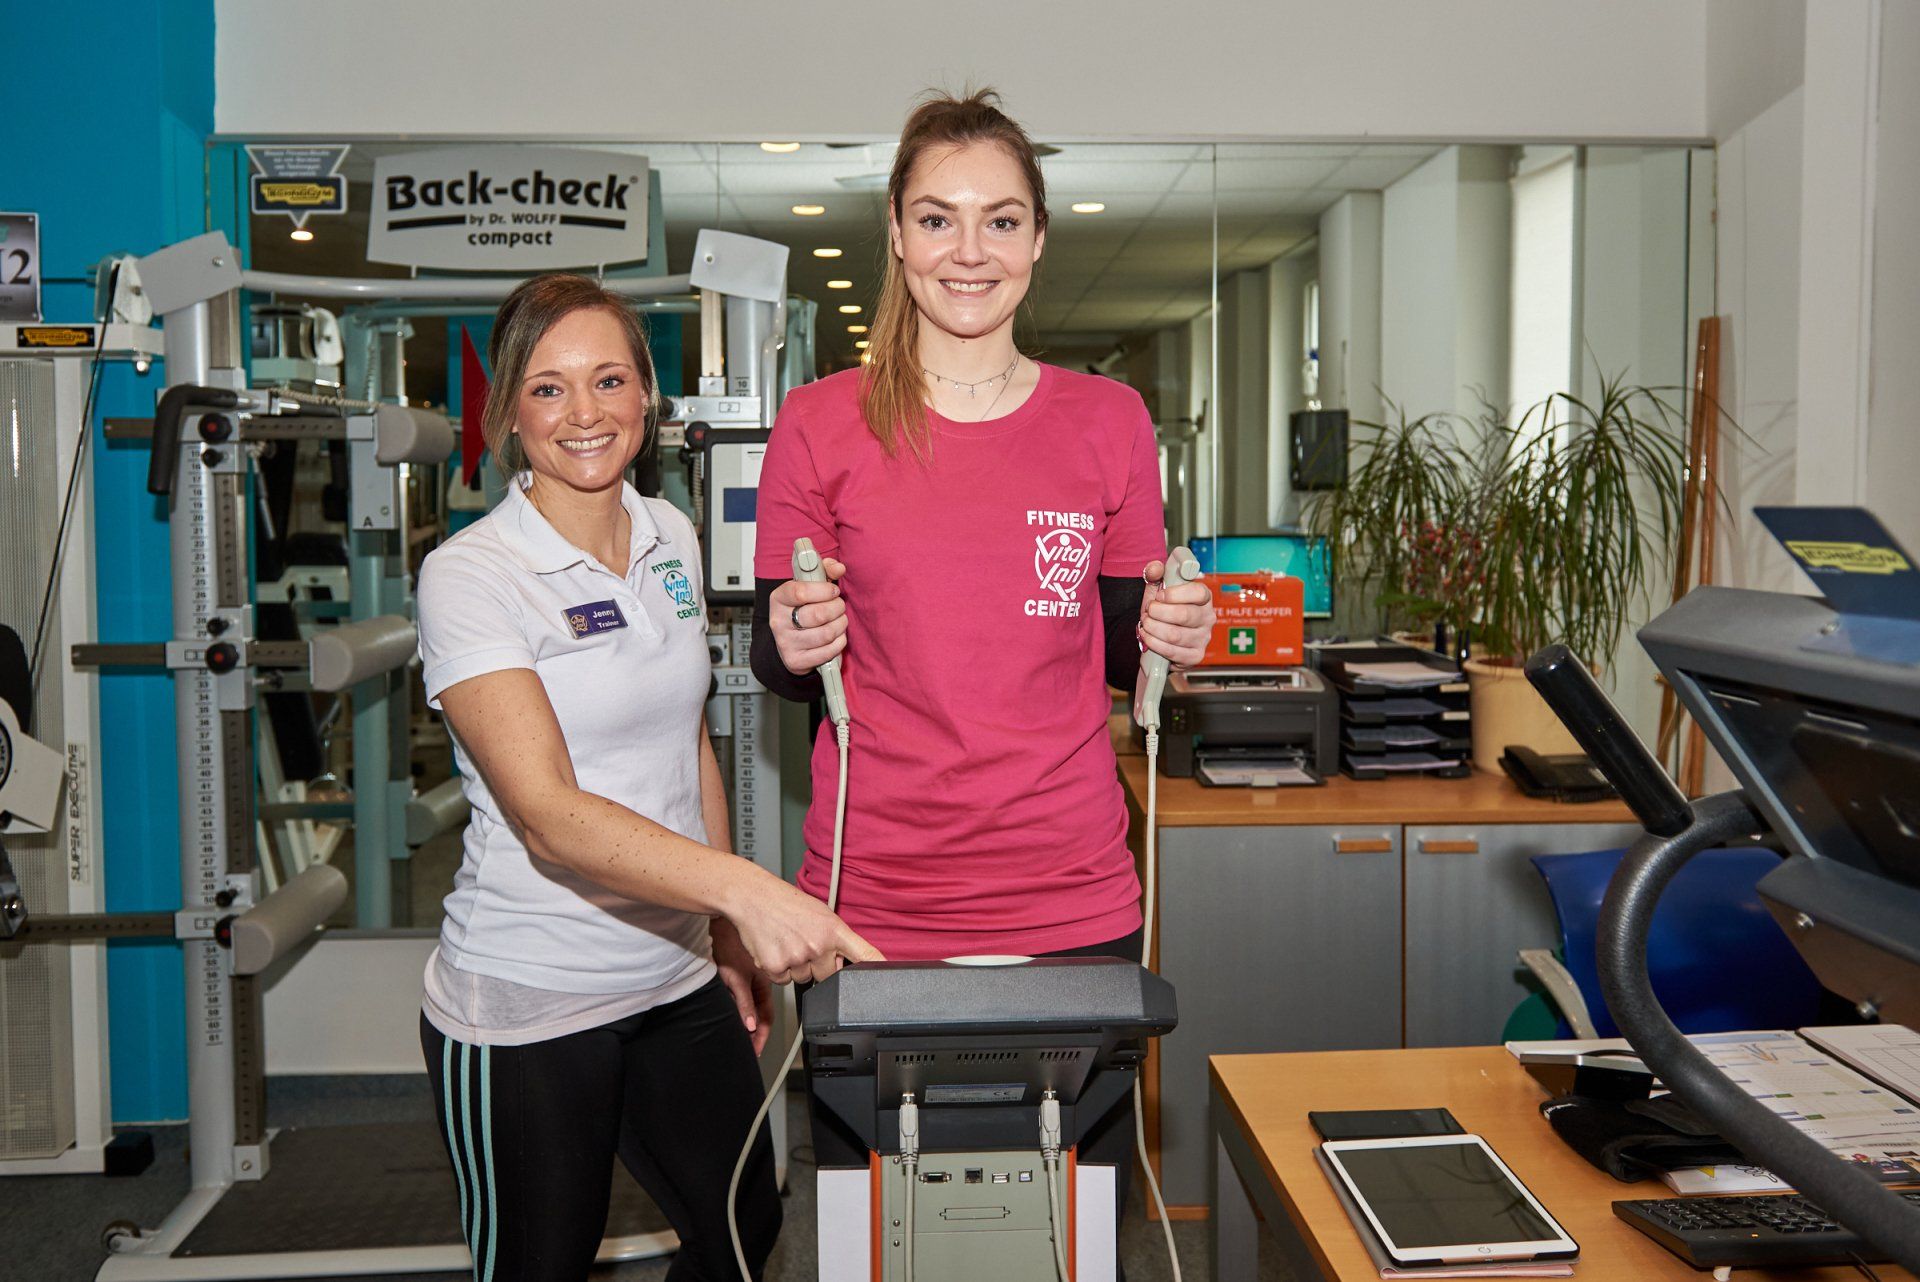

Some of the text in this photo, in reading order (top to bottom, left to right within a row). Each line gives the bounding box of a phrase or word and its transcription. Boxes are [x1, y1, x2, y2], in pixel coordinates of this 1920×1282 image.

[469, 213, 557, 227] by Dr. WOLFF
[467, 231, 553, 248] compact
[363, 516, 373, 528] A
[1026, 510, 1095, 531] FITNESS
[1035, 535, 1092, 568] Vital
[651, 559, 684, 574] FITNESS
[663, 575, 689, 593] Vital
[1040, 563, 1081, 589] Inn
[674, 588, 691, 605] Inn
[592, 608, 615, 619] Jenny
[676, 607, 701, 619] CENTE
[1024, 599, 1081, 617] CENTER
[1226, 607, 1252, 616] HILFE
[1255, 607, 1292, 616] KOFFER
[597, 620, 619, 629] Trainer
[68, 743, 80, 881] SUPER EXECUTIVE
